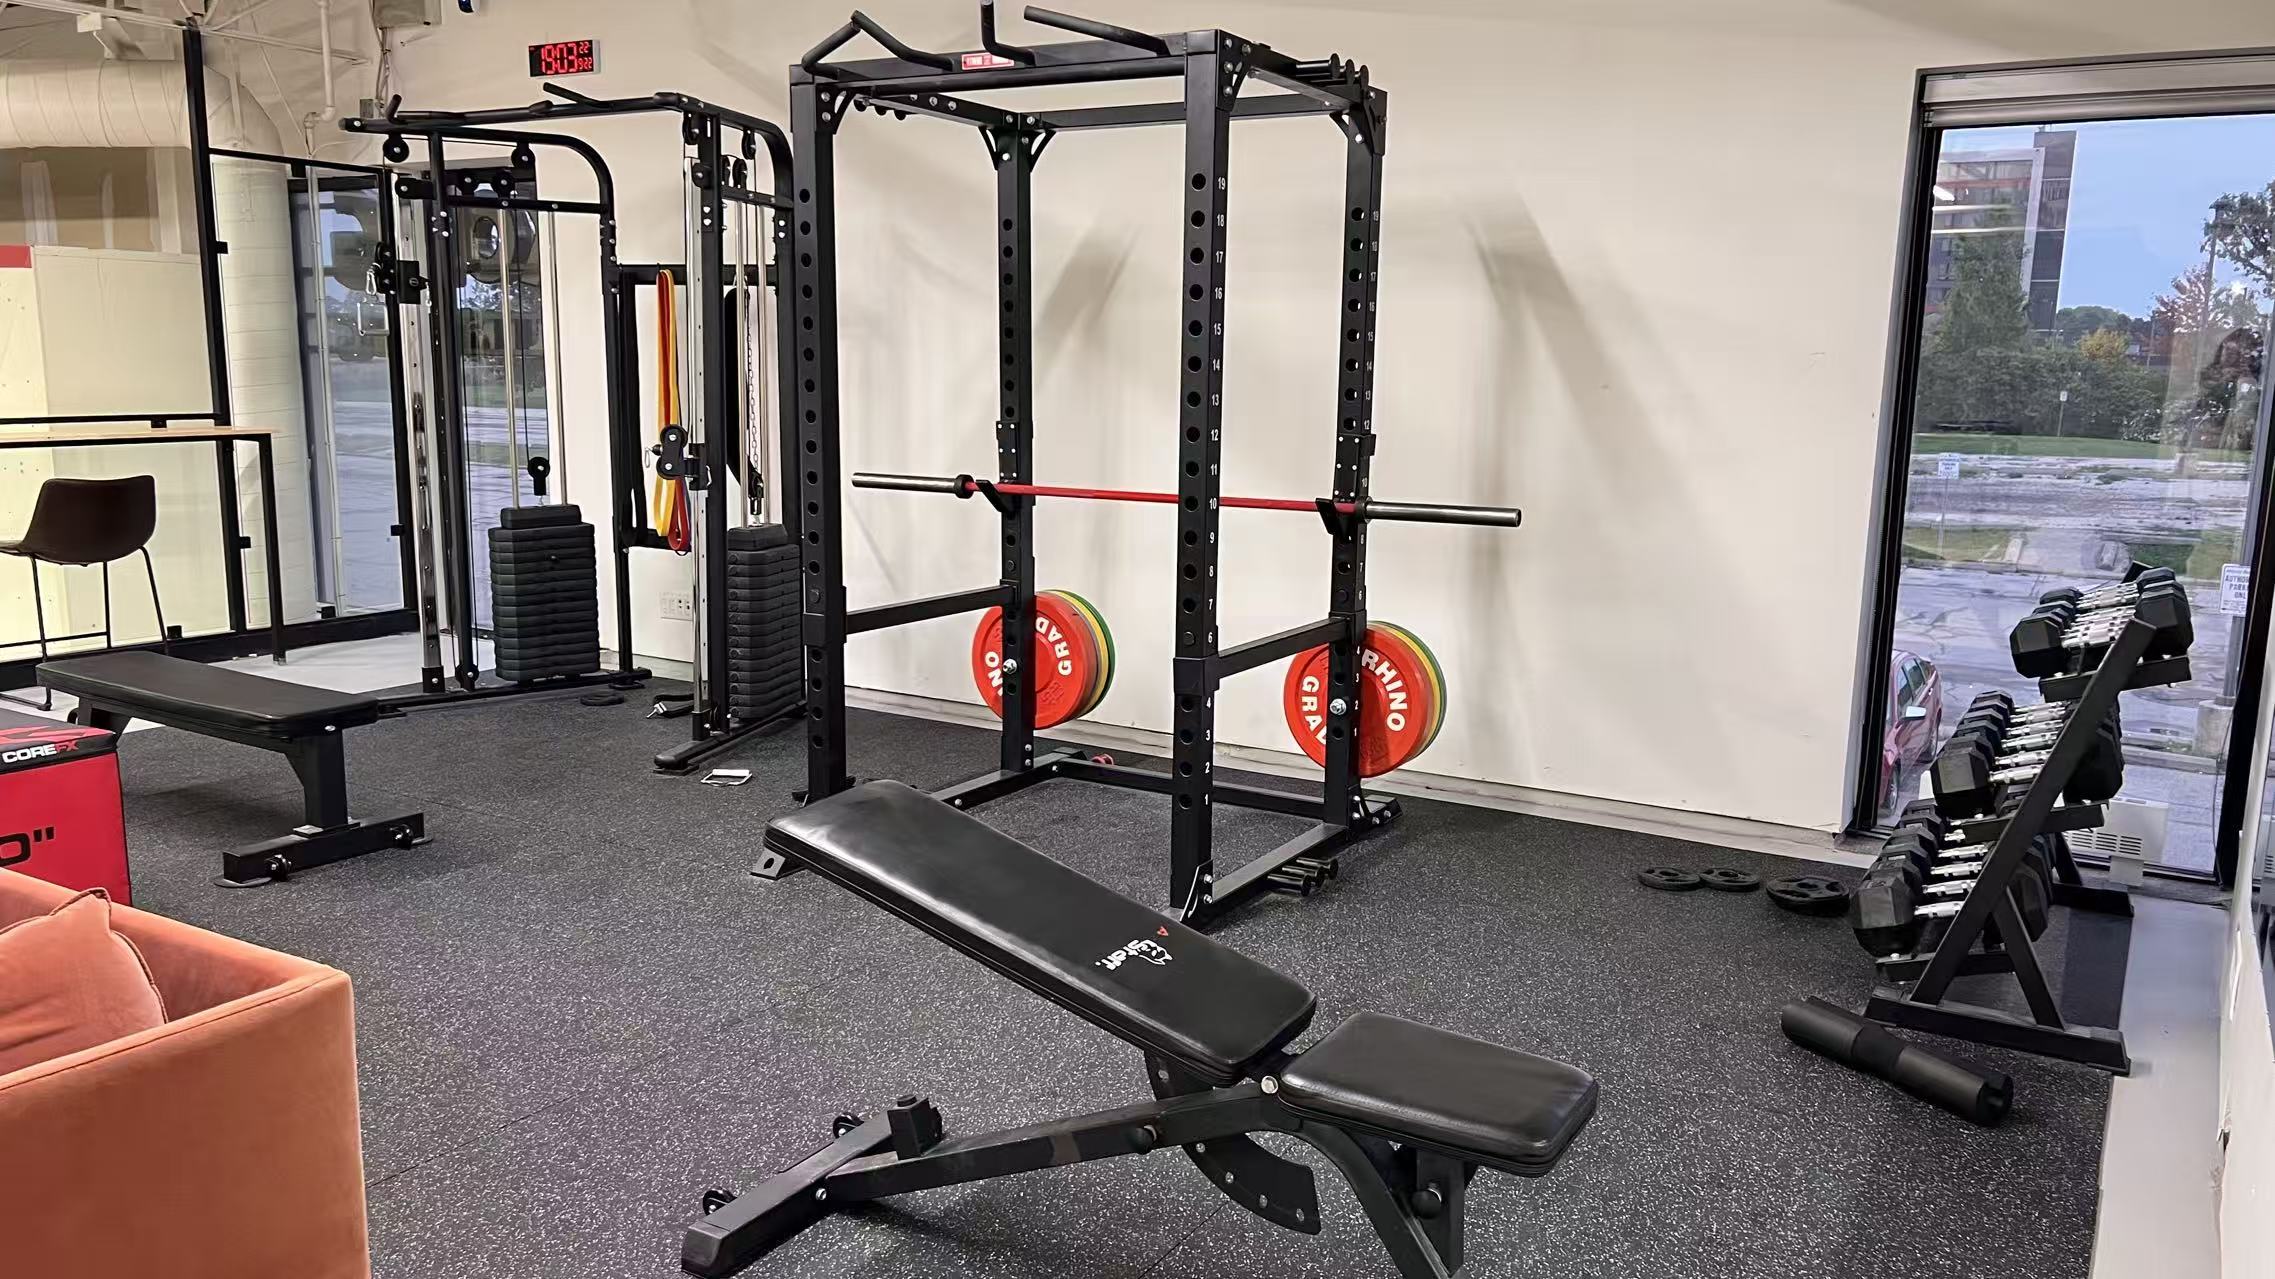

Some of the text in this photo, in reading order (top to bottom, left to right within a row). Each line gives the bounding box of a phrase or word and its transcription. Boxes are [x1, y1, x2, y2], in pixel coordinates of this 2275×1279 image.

[542, 43, 577, 74] 19:03
[1217, 176, 1226, 190] 19
[1216, 214, 1225, 227] 18
[1215, 251, 1224, 264] 17
[1214, 287, 1223, 300] 16
[1213, 323, 1222, 336] 15
[1212, 358, 1221, 372] 14
[1211, 393, 1220, 406] 13
[1210, 428, 1219, 441] 12
[1210, 463, 1218, 476] 11
[1209, 497, 1217, 510] 10
[1209, 531, 1215, 544] 9
[1208, 565, 1214, 577] 8
[1208, 598, 1214, 610] 7
[1207, 631, 1213, 644] 6
[1035, 617, 1072, 676] GRAD
[1361, 648, 1408, 732] RHINO
[1206, 696, 1212, 709] 4
[1205, 729, 1211, 741] 3
[2, 741, 78, 764] COREFX
[1204, 761, 1210, 774] 2
[1204, 793, 1209, 806] 1
